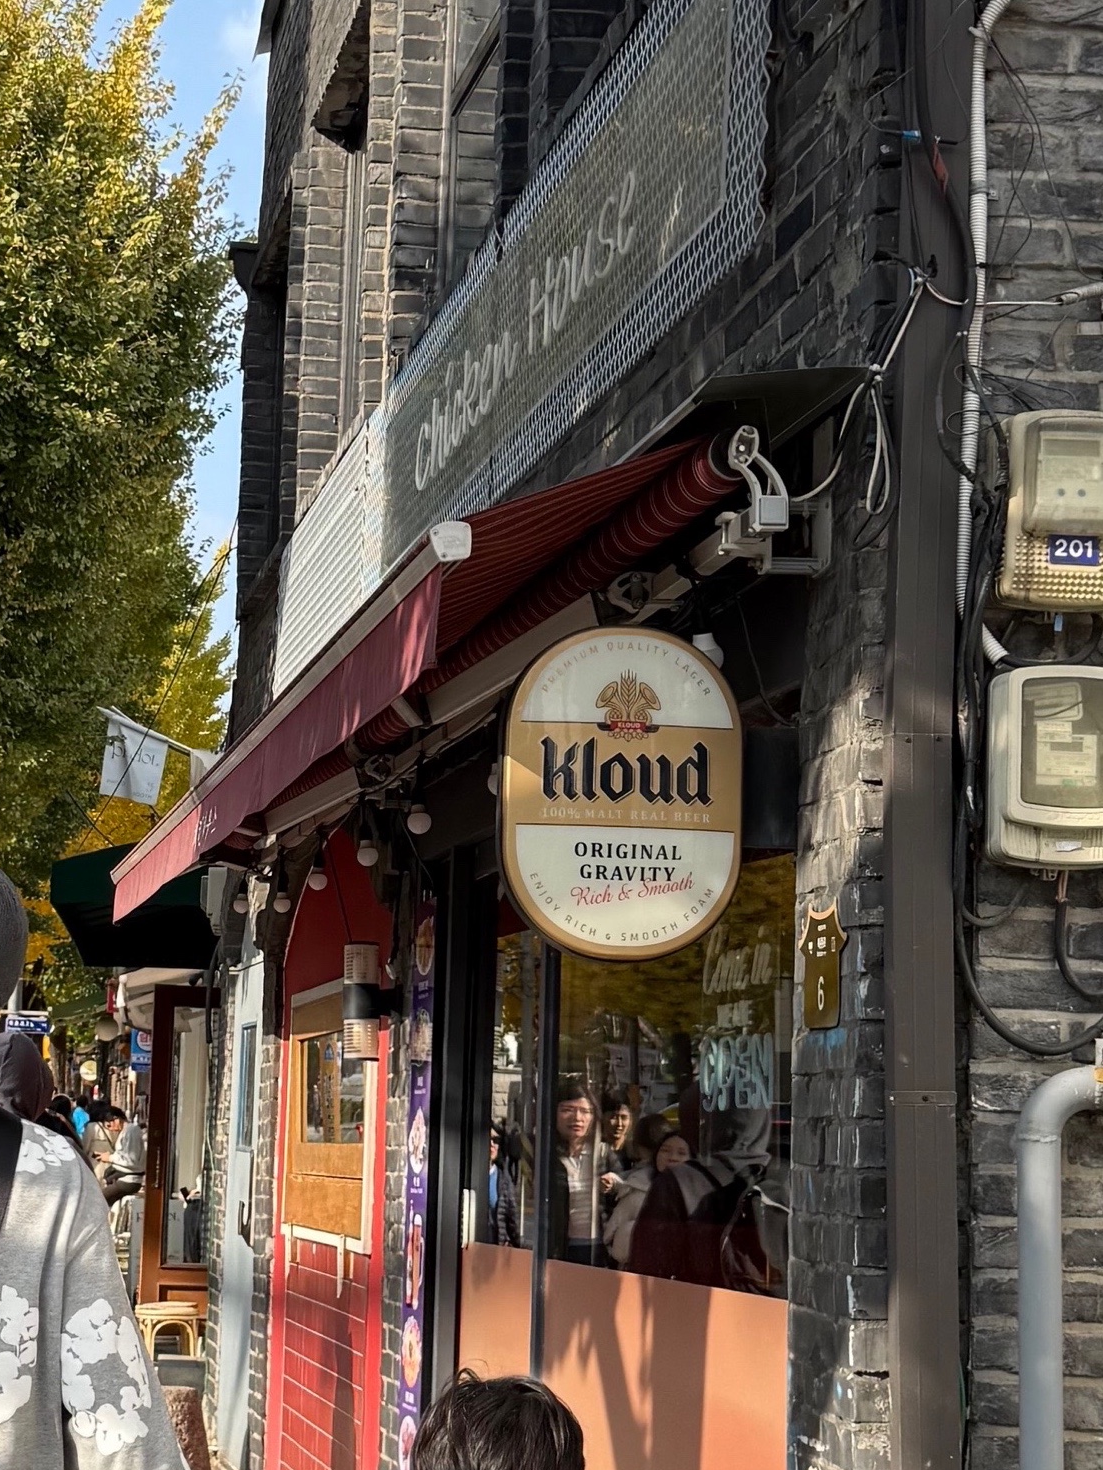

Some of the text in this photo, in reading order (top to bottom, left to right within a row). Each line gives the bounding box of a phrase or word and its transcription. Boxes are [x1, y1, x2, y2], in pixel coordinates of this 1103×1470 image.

[1054, 538, 1093, 558] 201
[542, 641, 711, 696] PREMIUM QUALITY LAGER
[541, 807, 711, 823] 100% MALT REAL BEER
[574, 841, 682, 861] ORIGINAL
[579, 863, 676, 882] GRAVITY
[570, 871, 696, 906] Rich & Smooth
[530, 872, 561, 912] ENJOY
[564, 914, 597, 937] RICH
[621, 921, 679, 941] SMOOTH
[683, 888, 714, 922] FOAM
[817, 976, 825, 1011] 6
